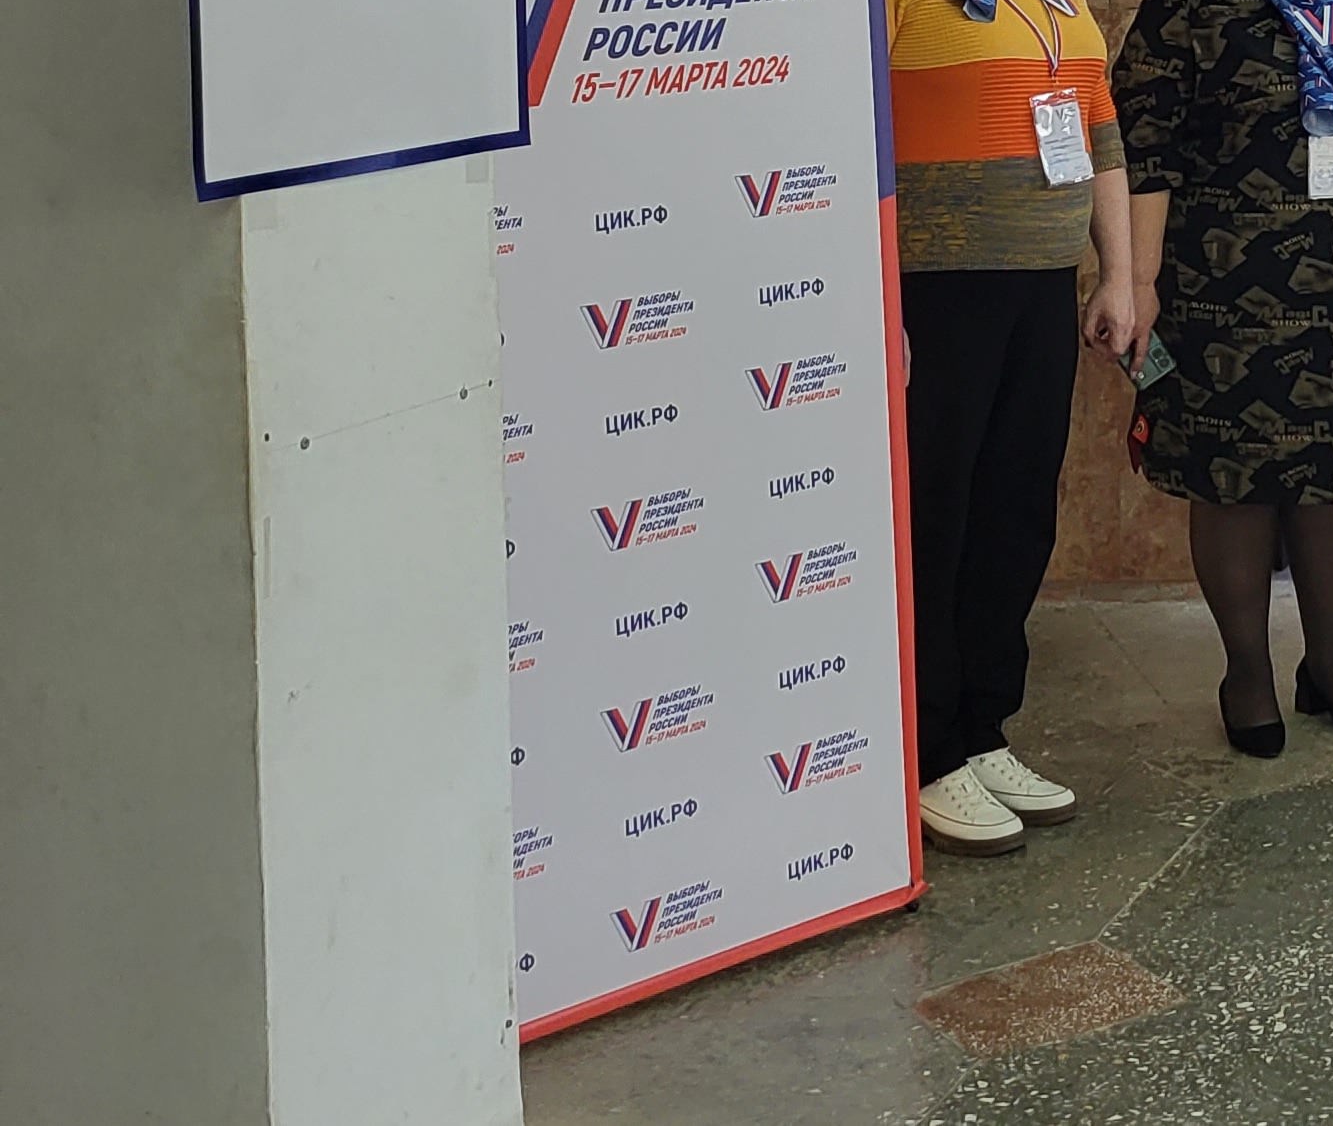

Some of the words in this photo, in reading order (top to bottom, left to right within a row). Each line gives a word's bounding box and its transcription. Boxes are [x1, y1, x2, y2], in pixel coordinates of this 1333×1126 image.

[583, 18, 726, 61] РОССИИ
[645, 61, 729, 96] МАРТА
[733, 55, 790, 87] 2024
[786, 165, 825, 178] ВЫБОРЫ
[782, 175, 836, 191] ПРЕЗИДЕНТА
[778, 190, 814, 204] РОССИИ
[794, 202, 815, 212] МАРТА
[596, 205, 667, 234] ЦИК.РФ
[637, 291, 681, 306] ВЫБОРЫ
[760, 278, 824, 306] ЦИК.РФ
[633, 301, 693, 320] ПРЕЗИДЕНТА
[628, 318, 668, 333] РОССИИ
[645, 330, 669, 342] МАРТА
[797, 353, 835, 369] ВЫБОРЫ
[793, 363, 846, 383] ПРЕЗИДЕНТА
[789, 380, 824, 395] РОССИИ
[804, 392, 825, 403] МАРТА
[606, 404, 677, 436] ЦИК.РФ
[770, 468, 834, 498] ЦИК.РФ
[647, 488, 691, 507] ВЫБОРЫ
[643, 498, 703, 520] ПРЕЗИДЕНТА
[639, 516, 678, 534] РОССИИ
[655, 529, 678, 541] МАРТА
[807, 542, 845, 560] ВЫБОРЫ
[803, 550, 856, 573] ПРЕЗИДЕНТА
[799, 569, 835, 586] РОССИИ
[815, 581, 835, 592] МАРТА
[616, 602, 687, 637] ЦИК.РФ
[780, 656, 845, 690] ЦИК.РФ
[657, 684, 701, 706] ВЫБОРЫ
[653, 694, 713, 720] ПРЕЗИДЕНТА
[648, 713, 688, 734] РОССИИ
[665, 726, 688, 739] МАРТА
[816, 729, 857, 750] ВЫБОРЫ
[812, 738, 868, 763] ПРЕЗИДЕНТА
[808, 757, 845, 776] РОССИИ
[823, 768, 845, 782] МАРТА
[626, 799, 697, 837] ЦИК.РФ
[789, 844, 853, 880] ЦИК.РФ
[666, 880, 710, 904] ВЫБОРЫ
[662, 888, 722, 917] ПРЕЗИДЕНТА
[657, 910, 697, 932] РОССИИ
[674, 922, 697, 937] МАРТА
